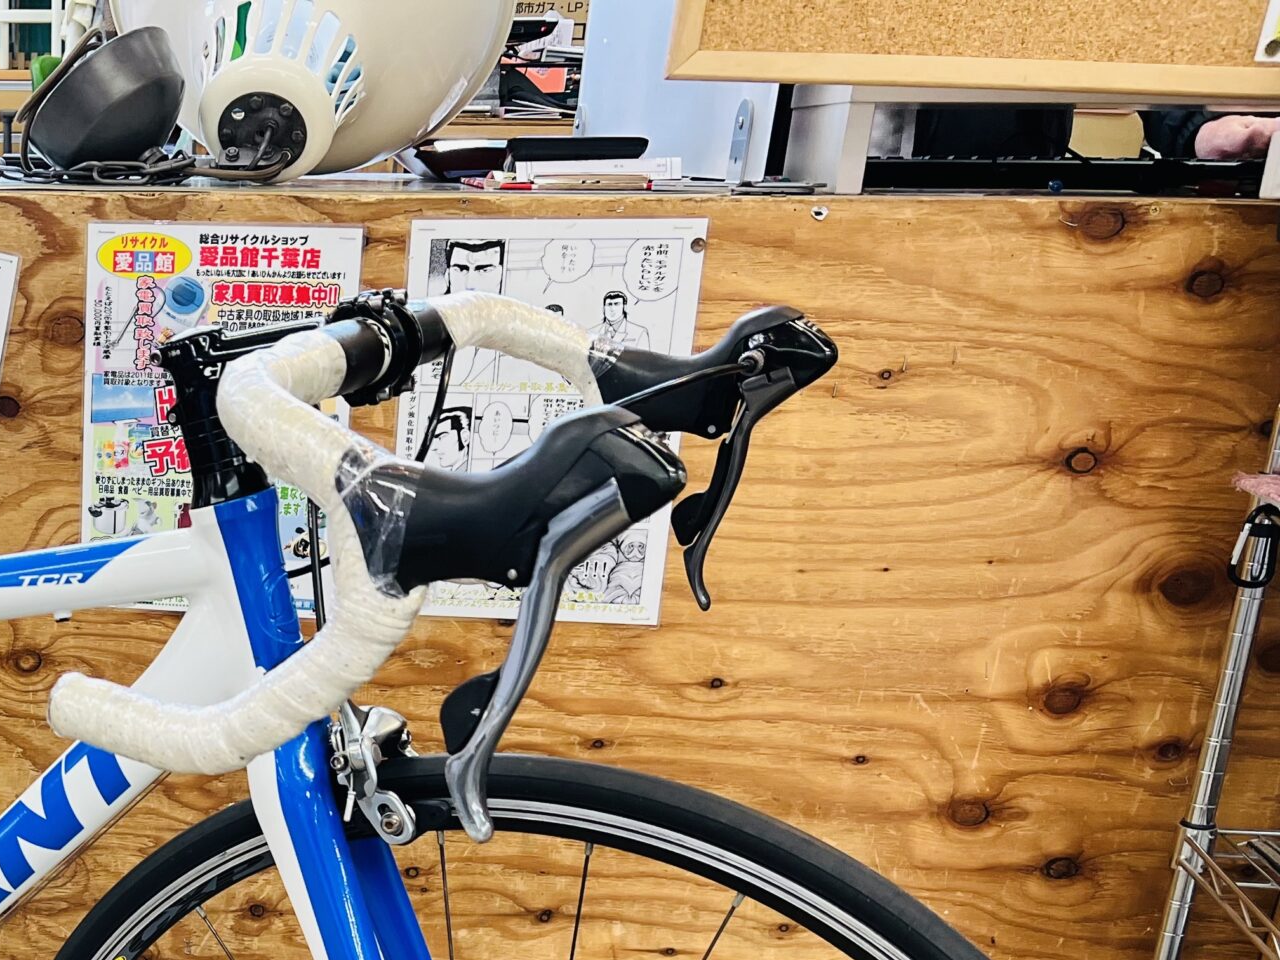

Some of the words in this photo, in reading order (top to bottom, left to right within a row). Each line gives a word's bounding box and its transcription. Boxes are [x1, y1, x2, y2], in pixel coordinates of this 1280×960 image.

[121, 236, 168, 249] リサイクル
[199, 234, 308, 245] 総合リサイクルショップ
[113, 252, 175, 273] 愛品館
[199, 247, 321, 269] 愛品館千葉店
[18, 572, 84, 588] TCR
